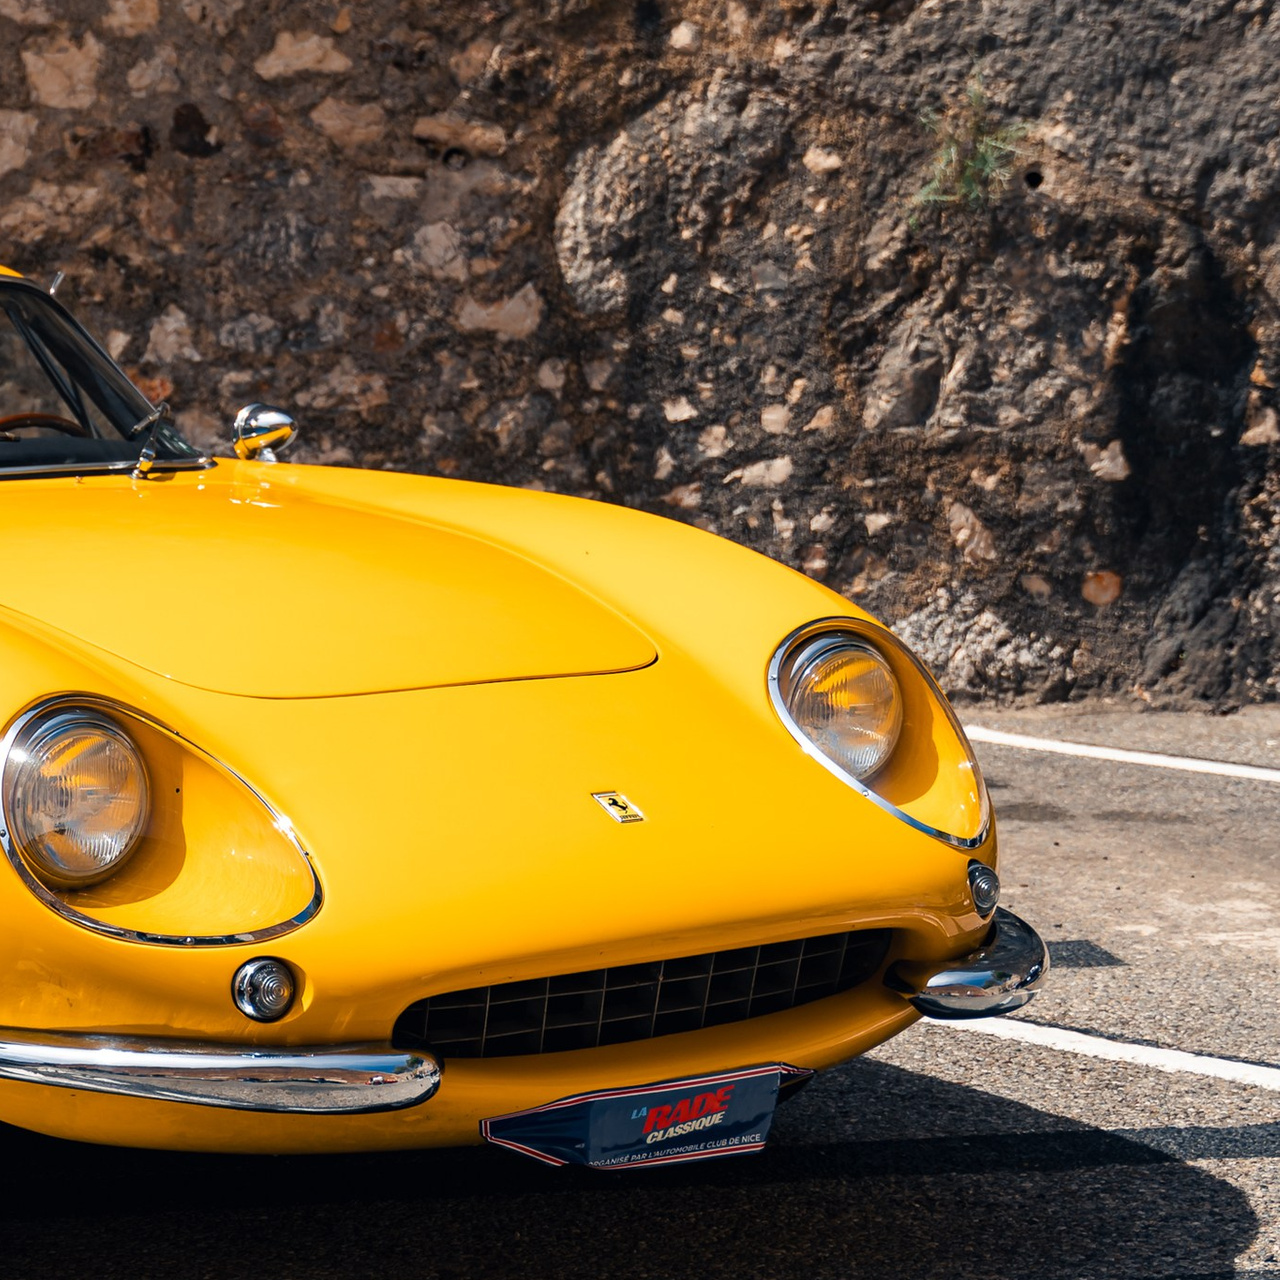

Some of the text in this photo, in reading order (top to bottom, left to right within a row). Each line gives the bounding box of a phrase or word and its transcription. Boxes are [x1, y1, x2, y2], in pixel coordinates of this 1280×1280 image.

[631, 1107, 647, 1119] LA
[642, 1084, 735, 1134] RADE
[646, 1111, 725, 1144] CLASSIQUE
[631, 1152, 646, 1162] PAR
[649, 1143, 705, 1158] L'AUTOMOBILE
[706, 1138, 728, 1148] CLUB
[729, 1136, 740, 1144] DE
[741, 1134, 761, 1143] NICE
